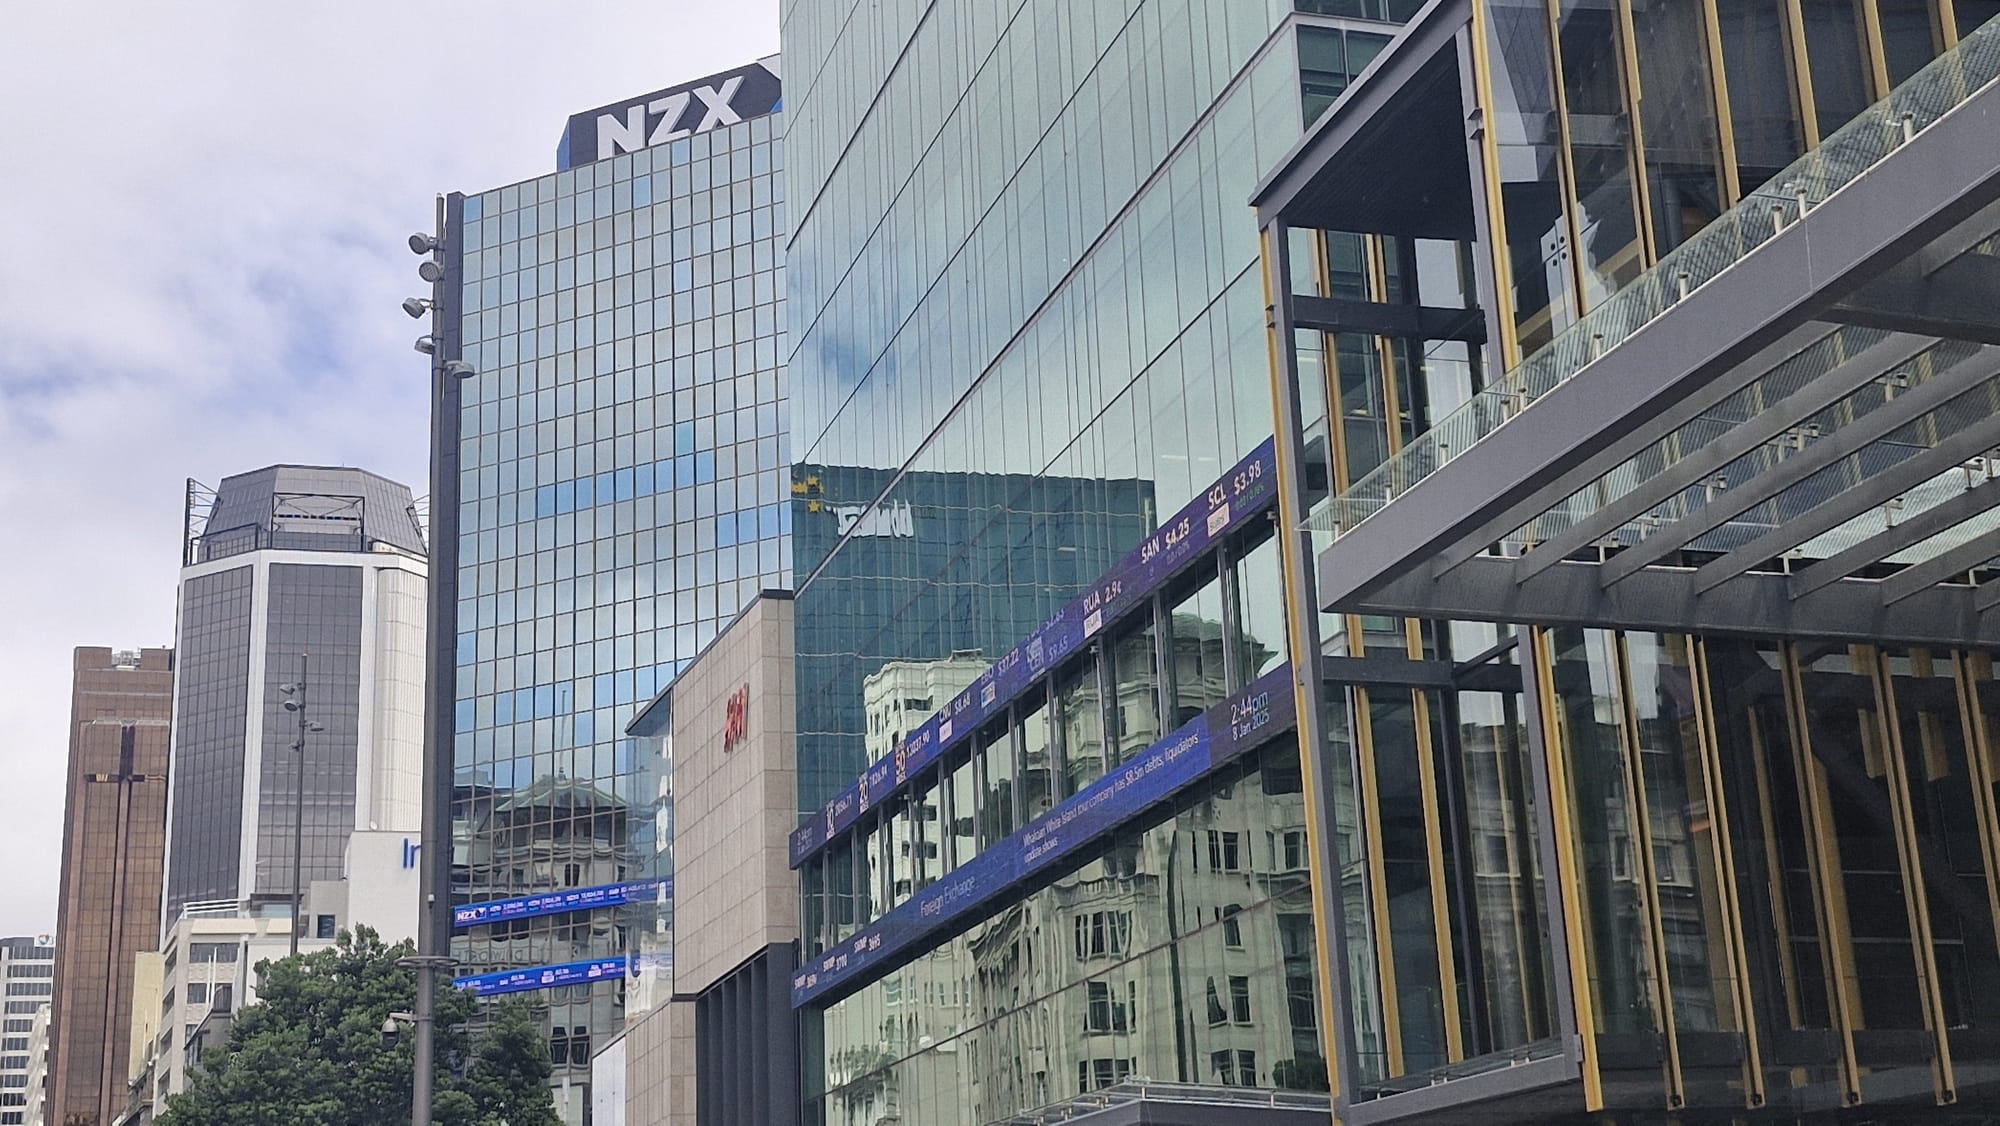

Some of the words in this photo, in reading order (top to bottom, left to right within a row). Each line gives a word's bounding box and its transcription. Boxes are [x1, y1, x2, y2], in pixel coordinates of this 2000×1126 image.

[597, 75, 744, 161] NZX
[1208, 483, 1226, 510] SCL
[1234, 460, 1261, 495] $3.98
[1141, 536, 1160, 564] SAN
[1165, 517, 1190, 550] $4.25
[1083, 590, 1100, 615] RUA
[1231, 692, 1268, 725] 2:44pm
[1232, 727, 1238, 741] 8
[1239, 722, 1251, 738] Jan
[1252, 708, 1270, 729] 2025
[920, 889, 944, 918] Foreign
